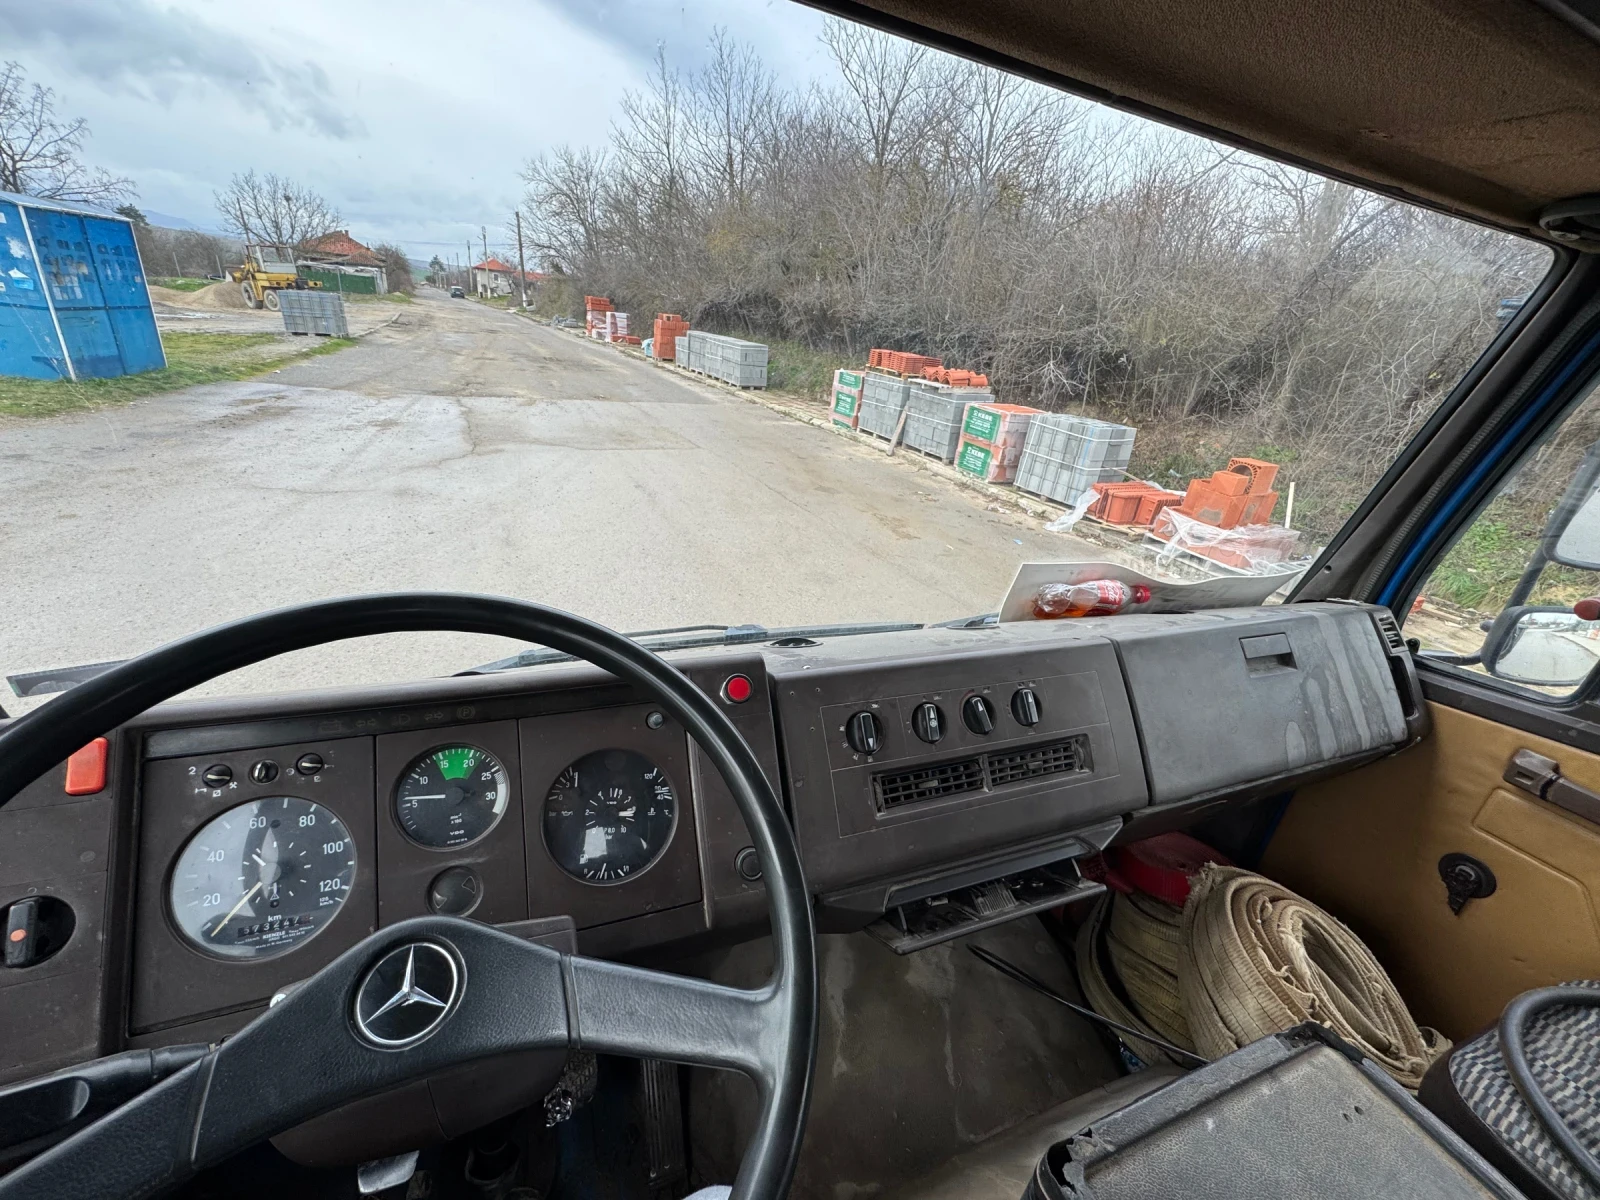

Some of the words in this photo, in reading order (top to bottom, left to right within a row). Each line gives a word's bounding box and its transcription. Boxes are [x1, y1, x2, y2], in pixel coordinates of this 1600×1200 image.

[440, 760, 449, 768] 15
[463, 759, 475, 767] 20
[188, 766, 196, 775] 2
[419, 776, 429, 784] 10
[481, 772, 492, 780] 25
[485, 792, 496, 800] 30
[412, 800, 418, 808] 5
[250, 816, 267, 829] 60
[299, 814, 316, 827] 80
[323, 841, 344, 855] 100
[207, 850, 225, 863] 40
[319, 878, 341, 892] 120
[203, 893, 221, 907] 20
[267, 914, 282, 922] km
